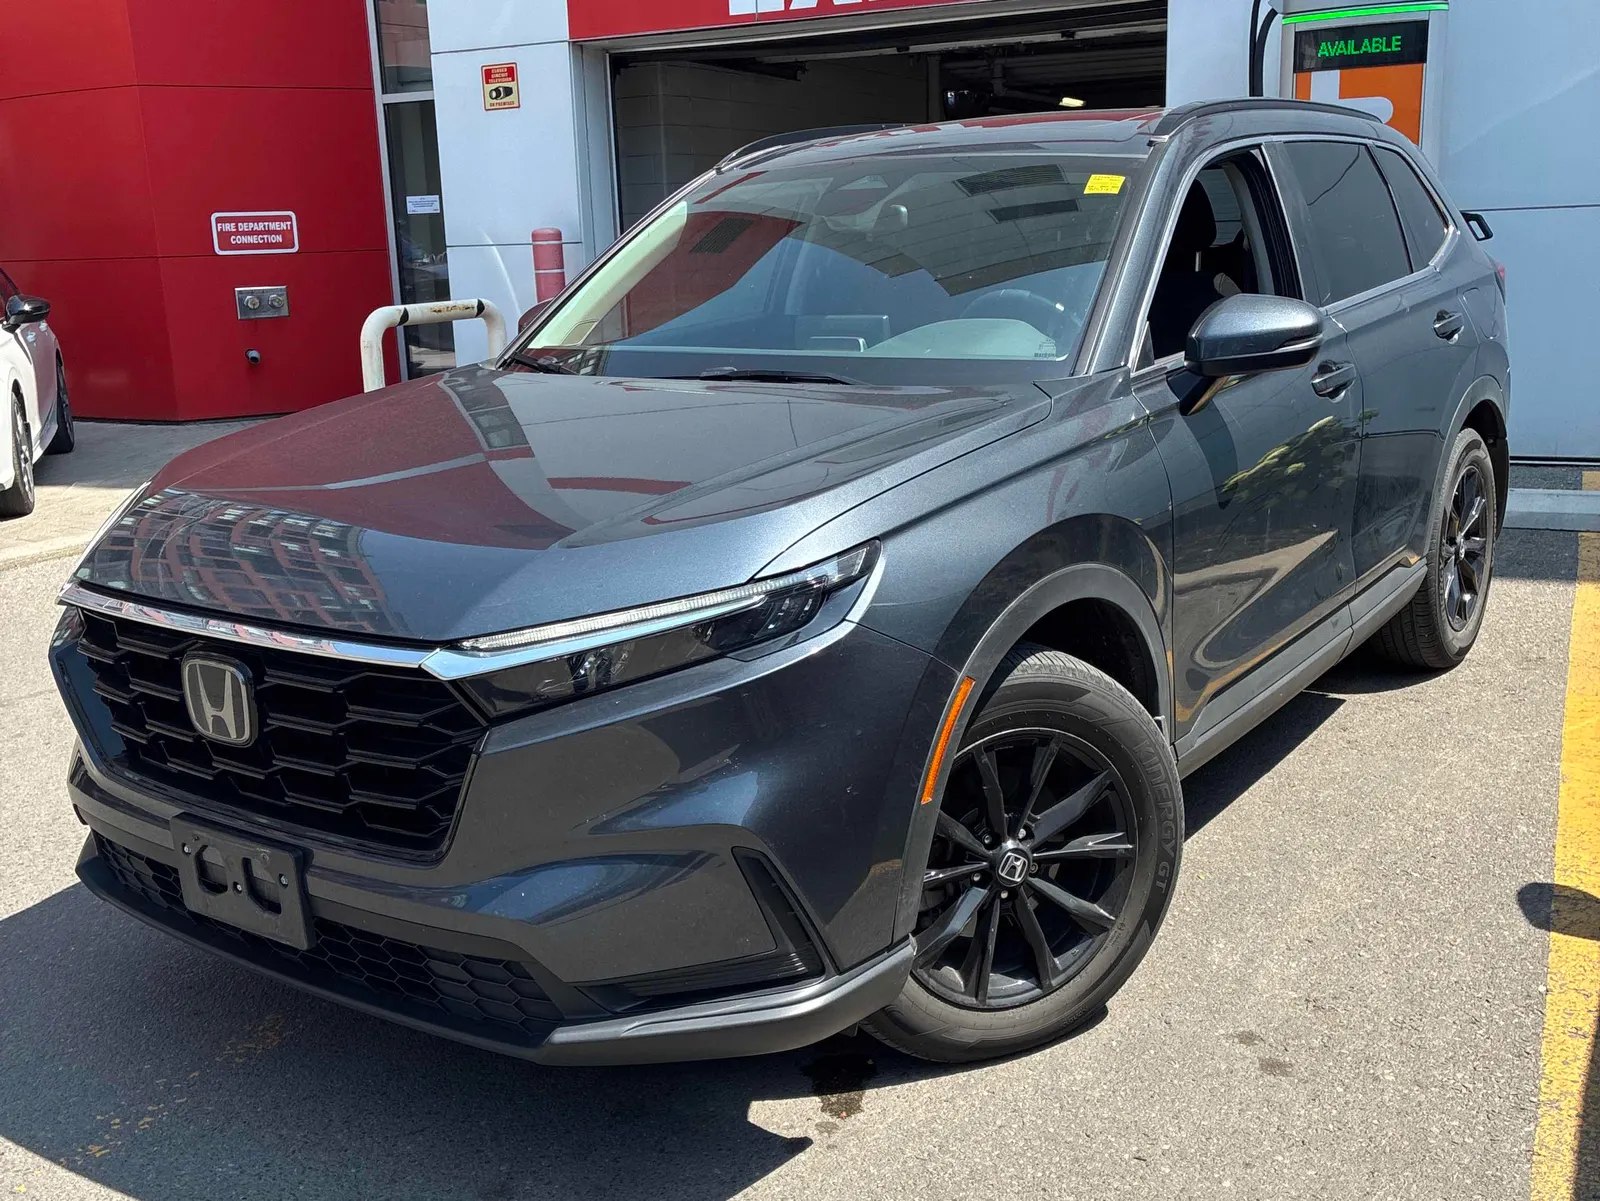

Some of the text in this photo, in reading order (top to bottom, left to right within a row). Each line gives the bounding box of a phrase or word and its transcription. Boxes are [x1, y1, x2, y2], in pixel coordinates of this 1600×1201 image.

[1317, 35, 1402, 57] AVAILABLE
[217, 221, 292, 232] FIRE DEPARTMENT
[230, 234, 283, 244] CONNECTION
[1156, 861, 1170, 894] GT
